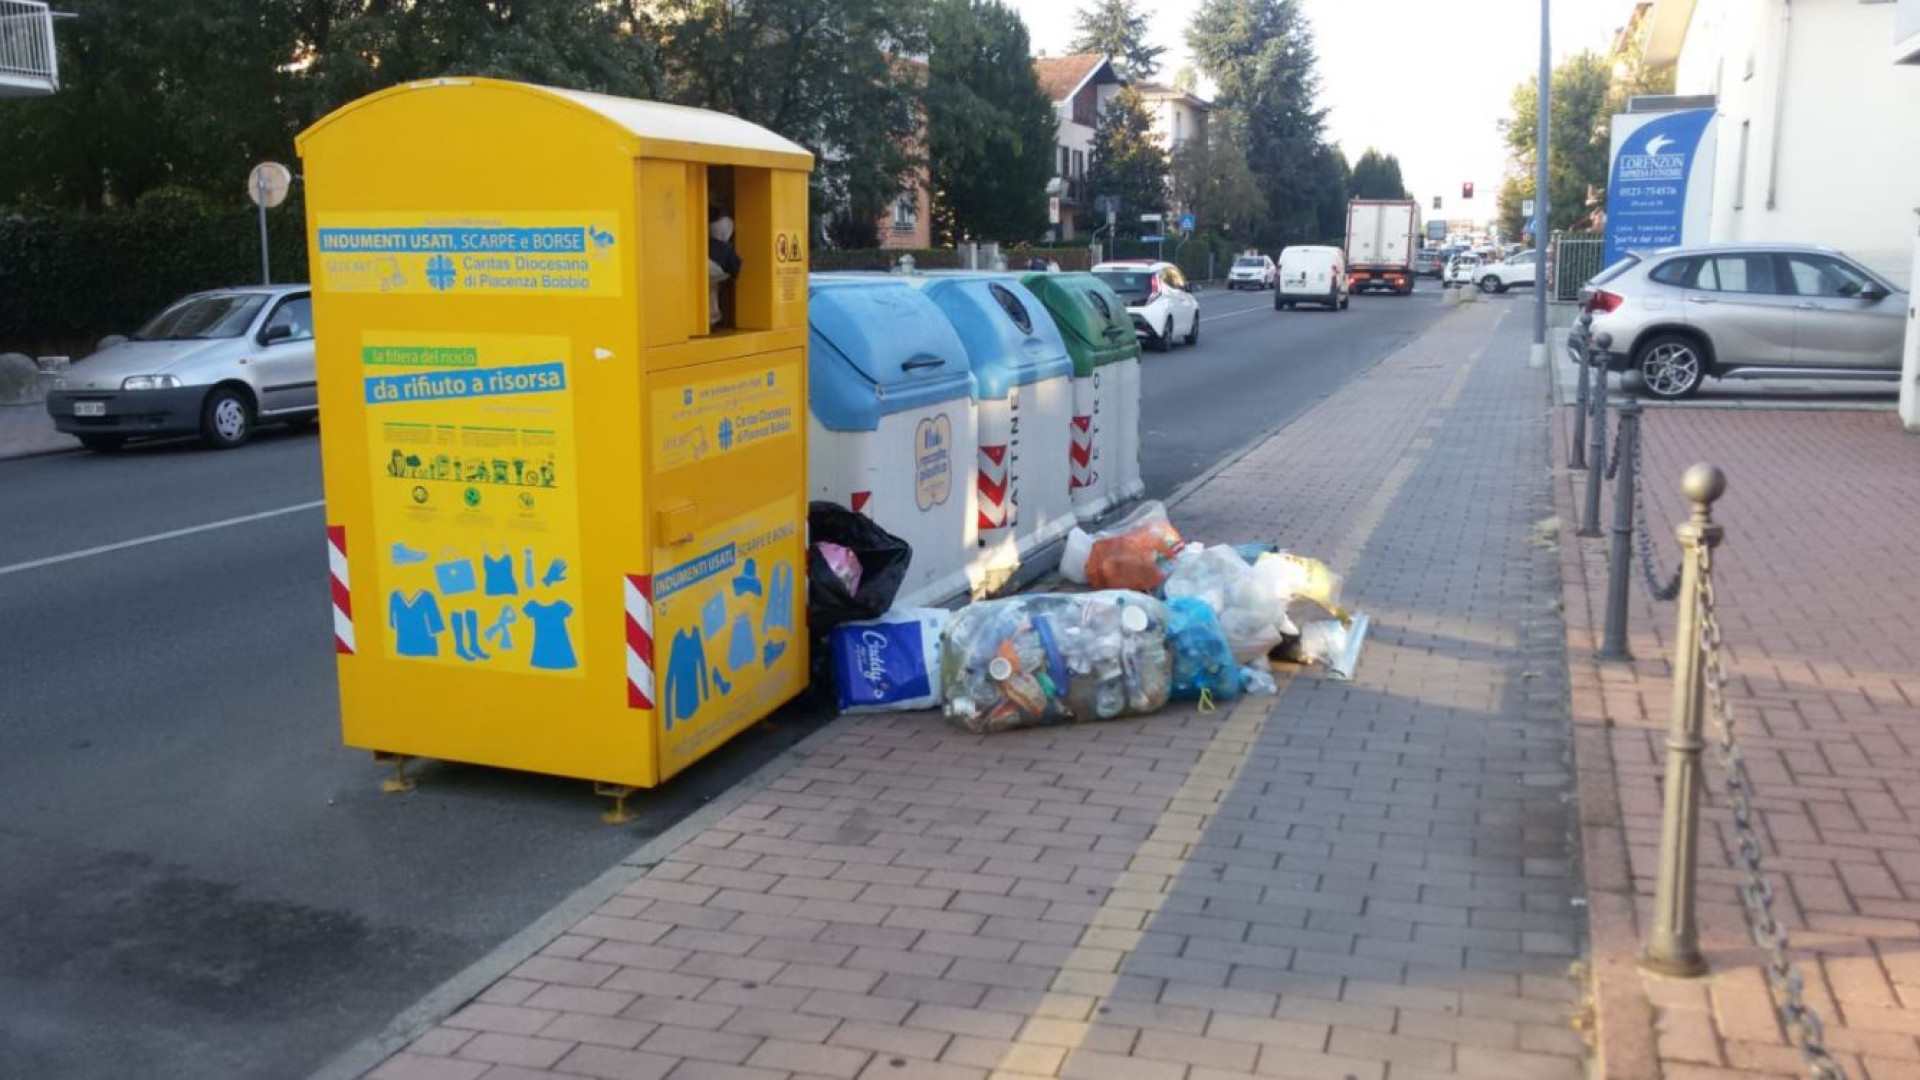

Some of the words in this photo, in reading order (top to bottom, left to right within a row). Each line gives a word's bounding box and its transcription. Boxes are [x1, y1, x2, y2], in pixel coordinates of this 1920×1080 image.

[1621, 156, 1683, 169] LORENZON
[323, 234, 406, 249] INDUMENTI
[461, 235, 516, 250] SCARPE
[520, 238, 529, 249] e
[533, 235, 580, 250] BORSE
[463, 256, 511, 271] Caritas
[515, 256, 589, 271] Diocesana
[464, 275, 476, 288] di
[479, 274, 537, 288] Piacenza
[542, 275, 589, 288] Bobbio
[421, 350, 439, 363] del
[374, 380, 398, 400] da
[404, 376, 466, 398] rifiuto
[472, 380, 484, 392] a
[489, 370, 561, 391] risorsa
[1010, 394, 1019, 528] LATTINE
[656, 561, 708, 596] INDUMENTI
[738, 533, 766, 558] SCARPE
